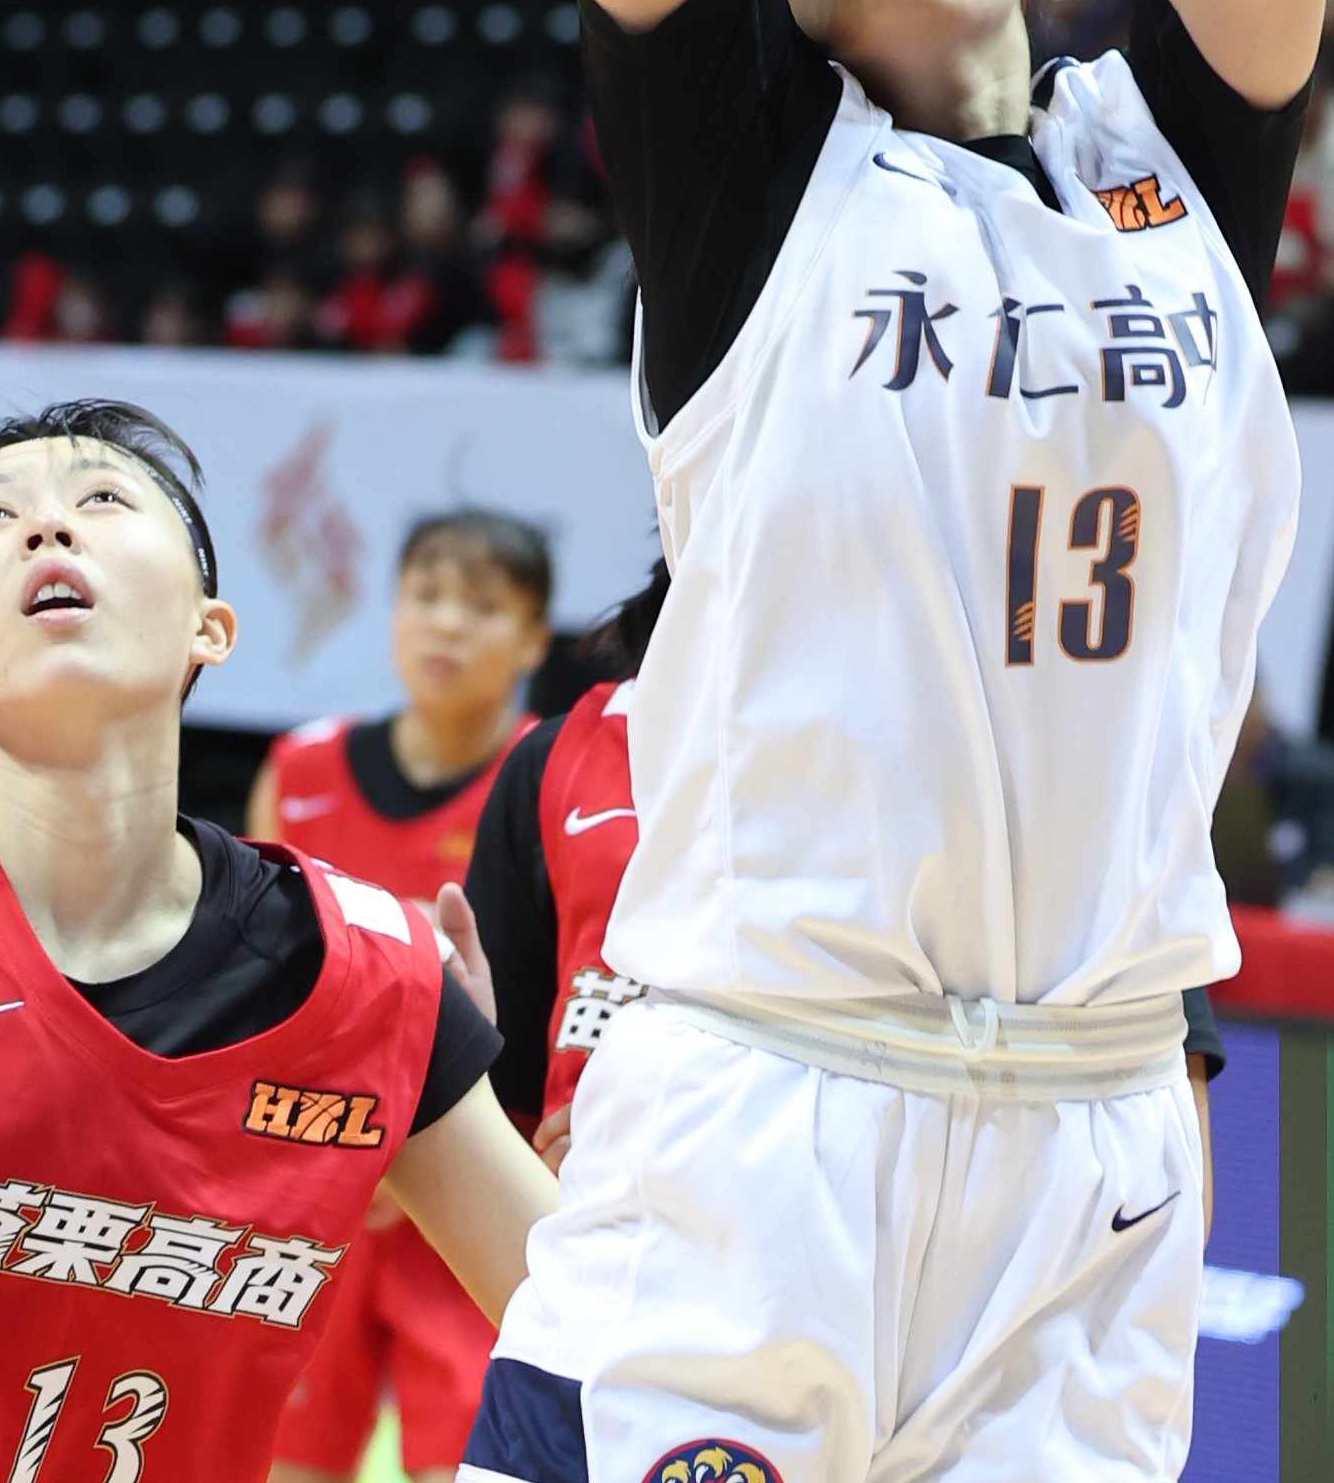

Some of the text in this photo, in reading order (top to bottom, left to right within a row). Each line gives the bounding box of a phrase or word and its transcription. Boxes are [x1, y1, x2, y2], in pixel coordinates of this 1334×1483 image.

[849, 271, 1217, 408] 永仁高中
[1005, 484, 1141, 667] 13
[243, 1079, 386, 1148] HBL
